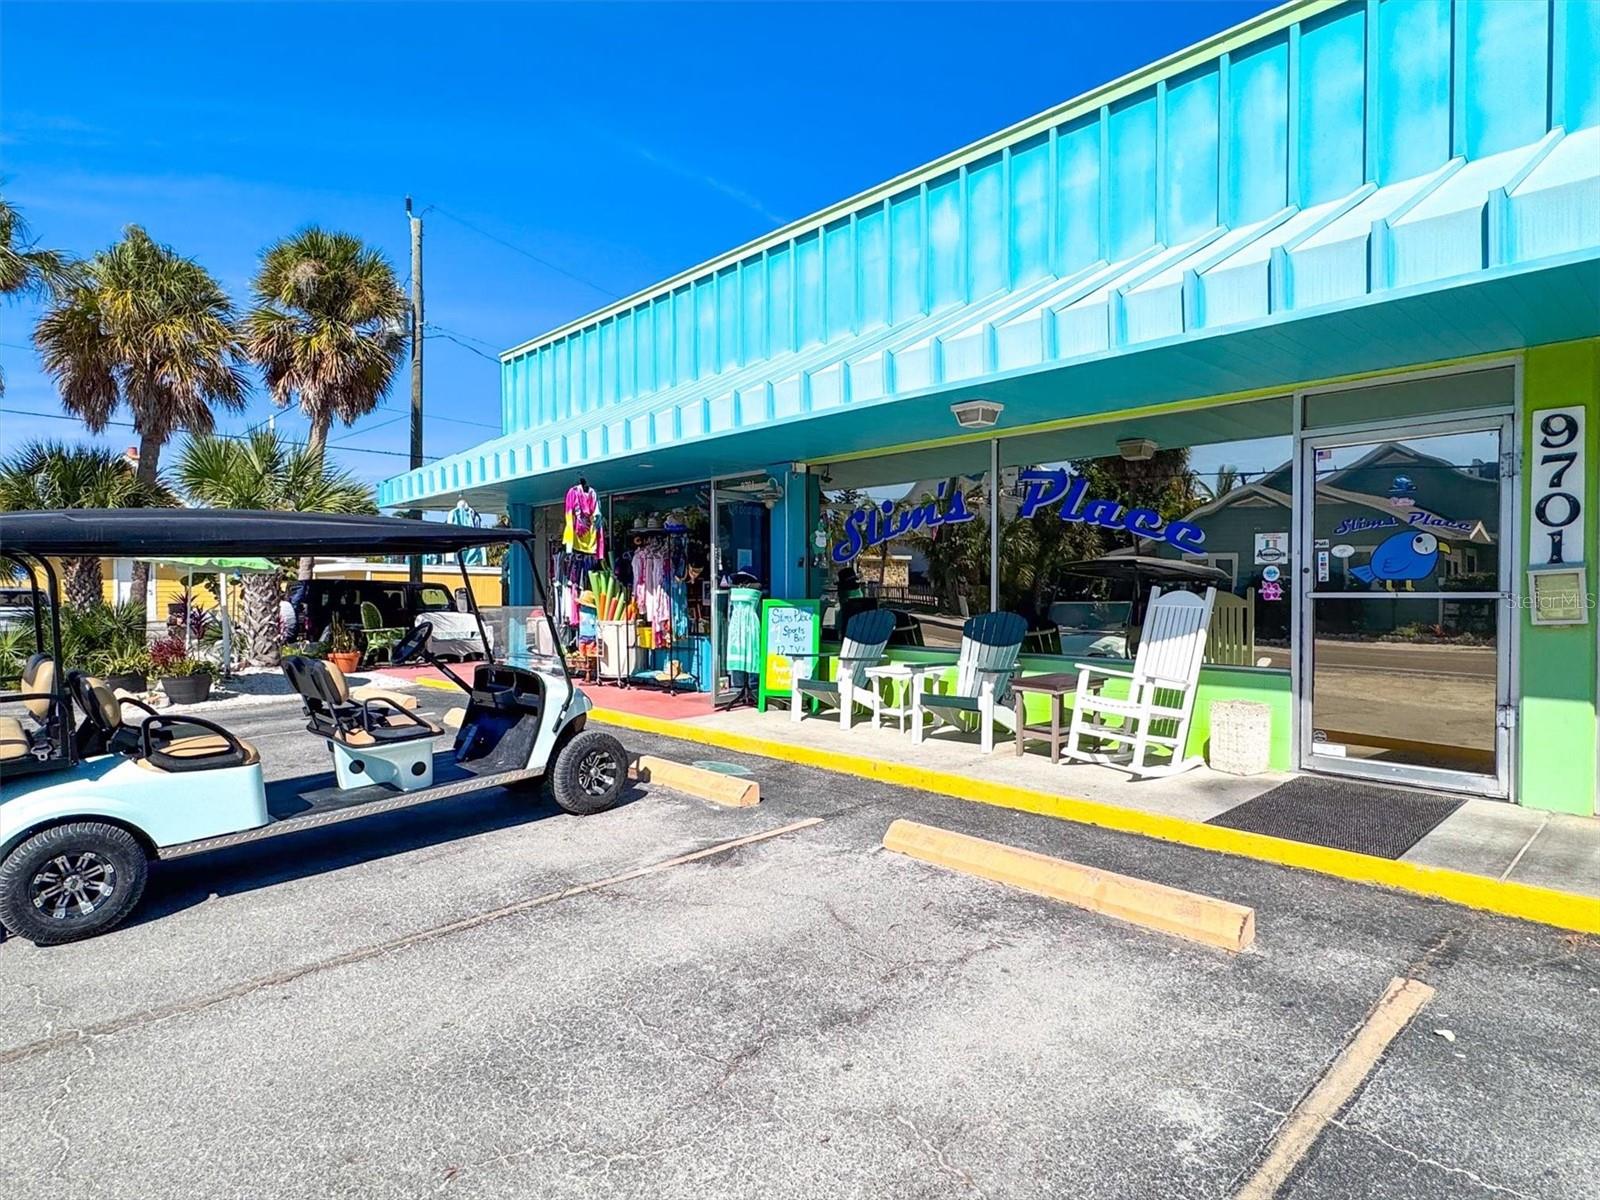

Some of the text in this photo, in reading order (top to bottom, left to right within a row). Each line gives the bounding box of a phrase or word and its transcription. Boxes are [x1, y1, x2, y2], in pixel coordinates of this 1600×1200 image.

[833, 471, 1208, 563] Slim's Place
[1408, 511, 1473, 533] Place
[1535, 413, 1581, 565] 9701
